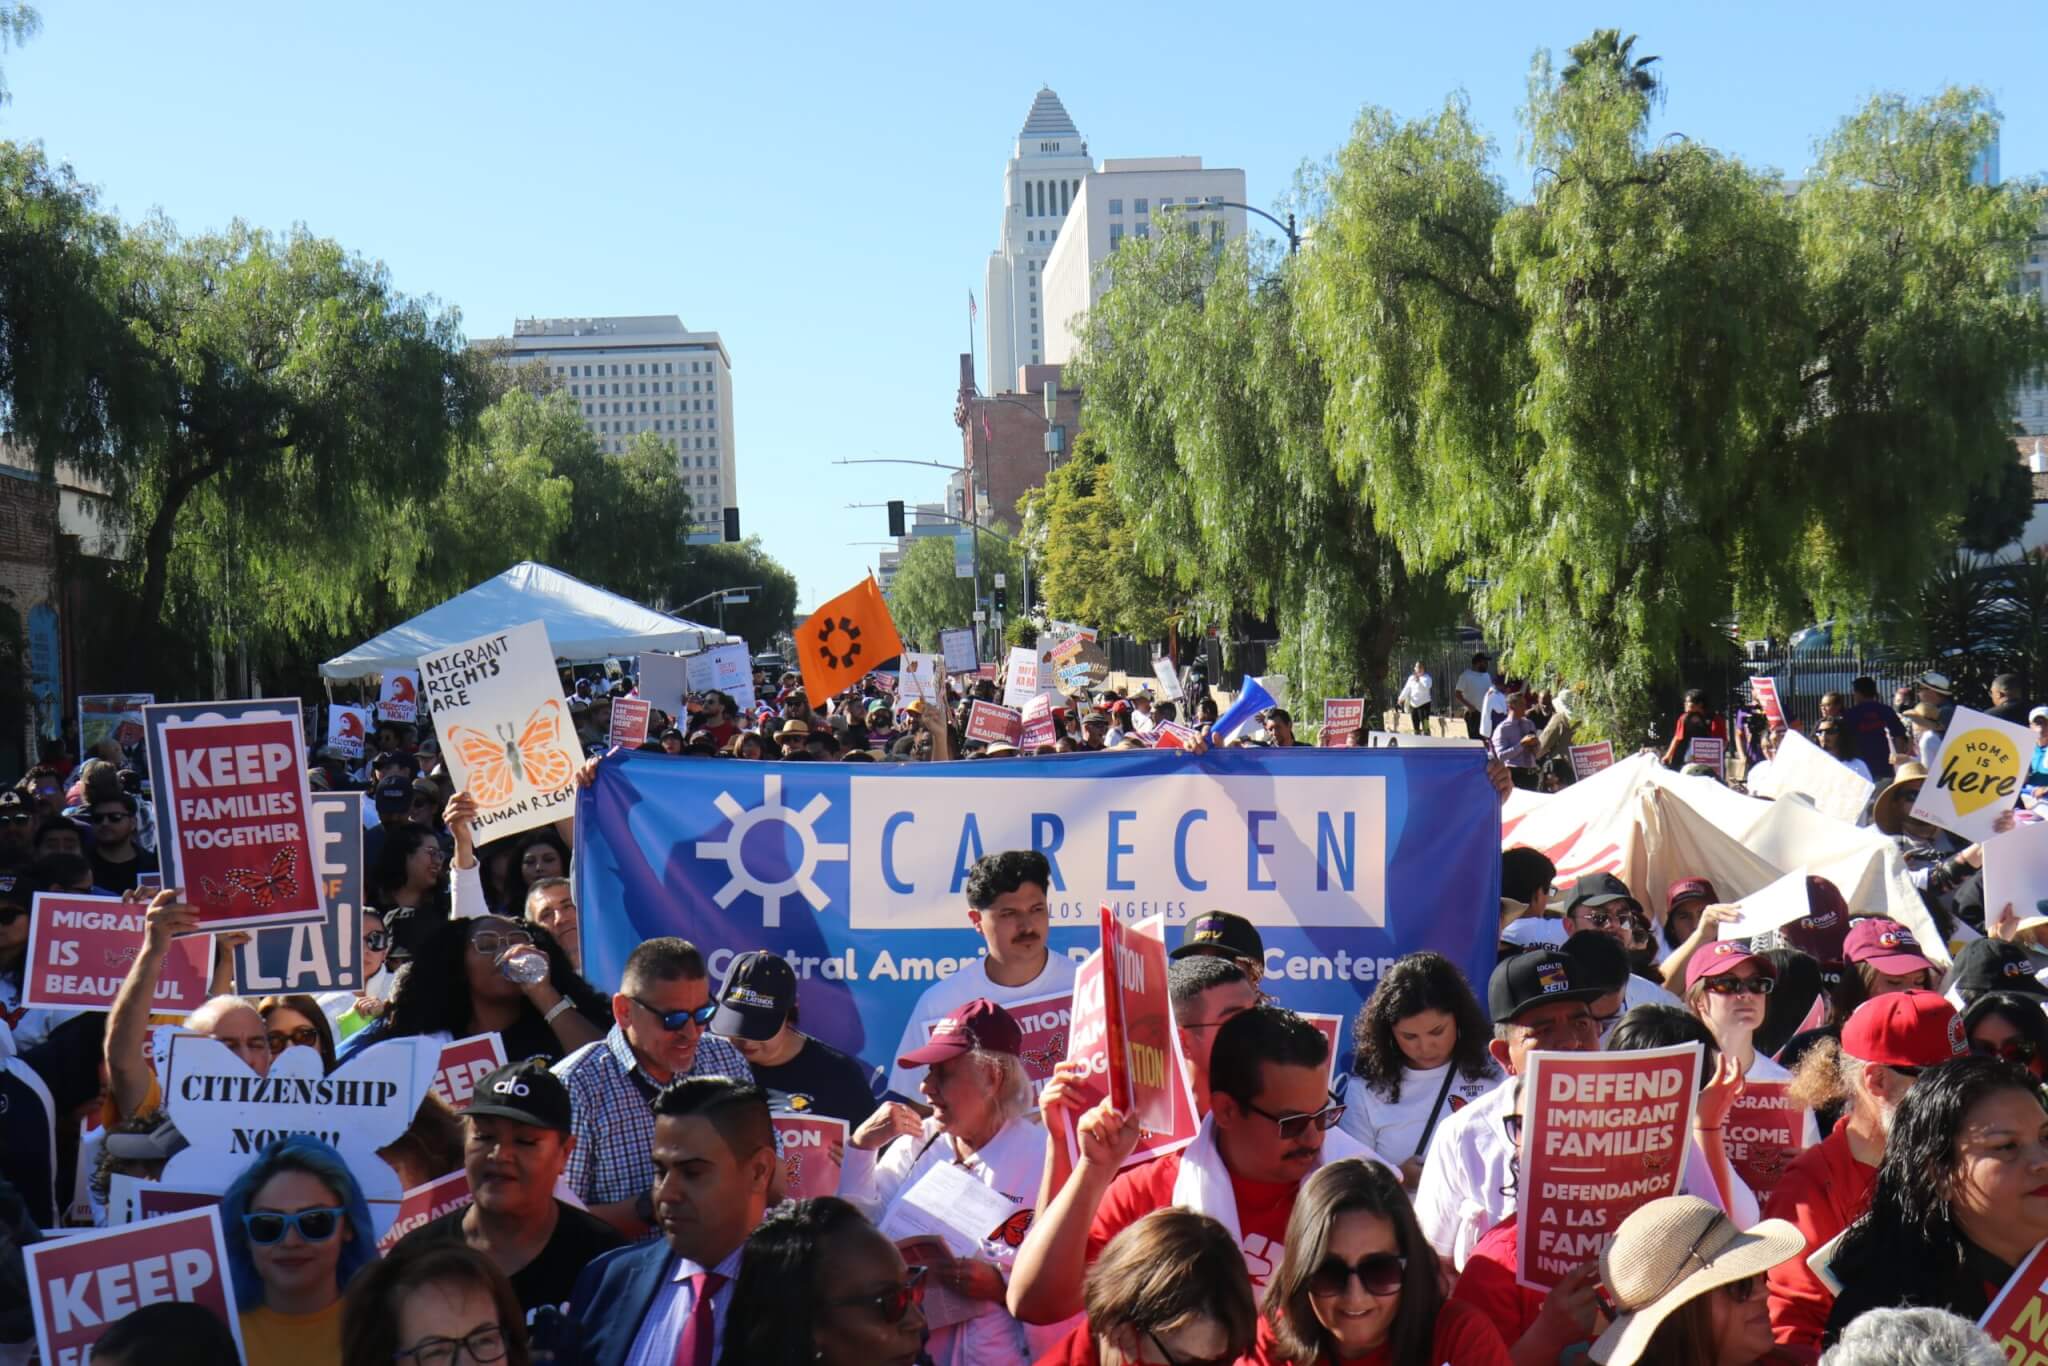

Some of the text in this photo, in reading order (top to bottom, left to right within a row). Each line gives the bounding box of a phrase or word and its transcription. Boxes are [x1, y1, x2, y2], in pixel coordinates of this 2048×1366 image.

[426, 635, 509, 677] MIGRANT
[427, 658, 501, 695] RIGHTS
[431, 689, 472, 713] ARE
[1327, 705, 1361, 718] KEEP
[174, 743, 293, 789] KEEP
[1966, 742, 2010, 764] HOME
[1976, 757, 1991, 768] IS
[1936, 755, 2018, 797] here
[180, 791, 297, 822] FAMILIES
[471, 786, 576, 832] HUMAN RIGH
[183, 822, 300, 850] TOGETHER
[880, 808, 1356, 896] CARECEN
[51, 910, 146, 933] MIGRAT
[1048, 901, 1186, 920] LOS NGELES
[48, 940, 80, 966] IS
[245, 902, 354, 990] LA!
[707, 947, 1396, 982] Ctral Ameri Center
[1543, 980, 1569, 994] SEIU
[180, 1074, 398, 1108] CITIZENSHIP
[493, 1075, 531, 1098] alo
[1549, 1067, 1683, 1103] DEFEND
[1546, 1102, 1680, 1129] IMMIGRANT
[1544, 1124, 1674, 1158] FAMILIES
[1720, 1125, 1791, 1145] LCOME
[1541, 1173, 1671, 1202] DEFENDAMOS
[1539, 1206, 1607, 1228] A LAS
[1538, 1229, 1614, 1258] FAMI
[48, 1248, 213, 1334] KEEP
